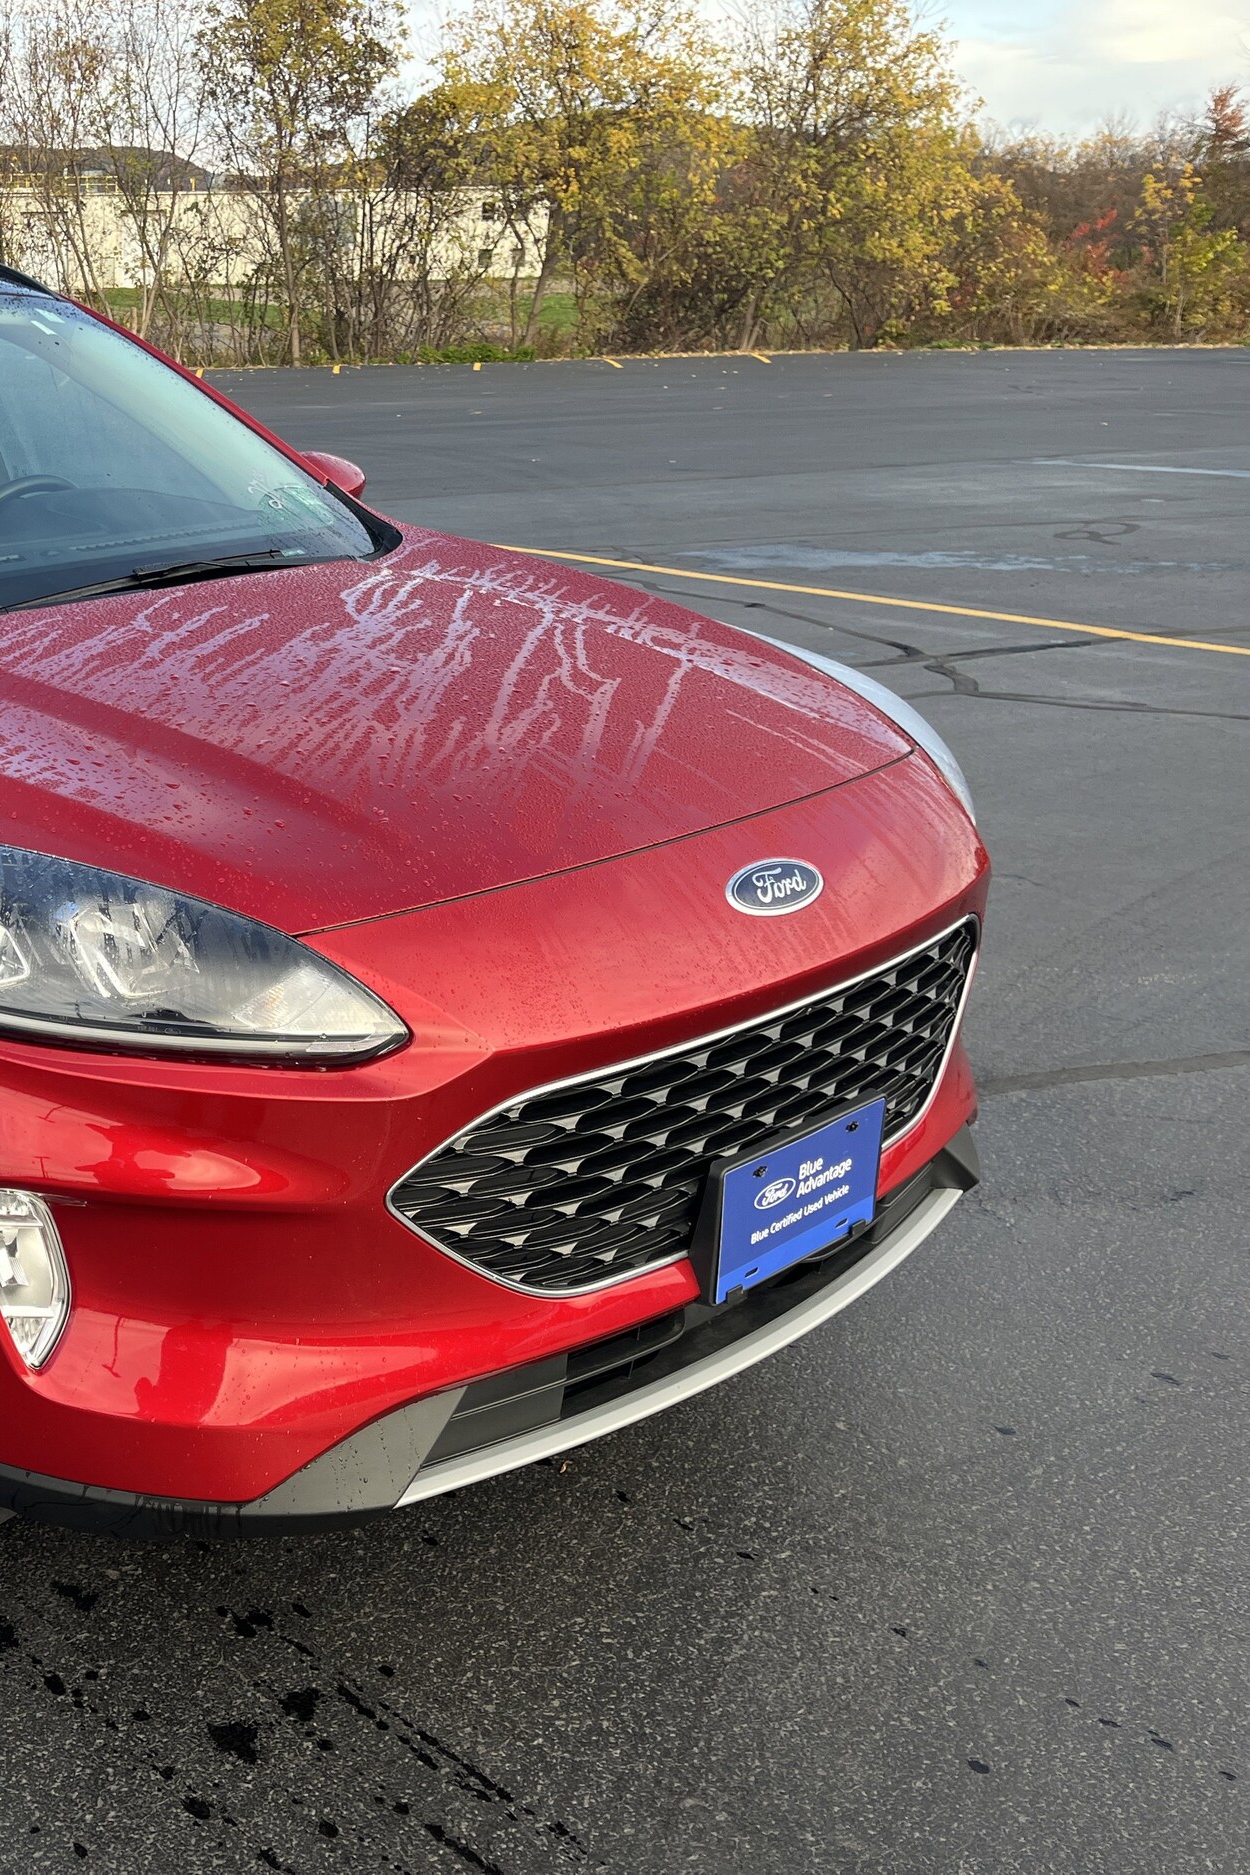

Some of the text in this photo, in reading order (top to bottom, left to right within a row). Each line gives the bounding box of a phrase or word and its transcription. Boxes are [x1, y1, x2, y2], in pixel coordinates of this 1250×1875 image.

[752, 867, 806, 903] Ford
[796, 1158, 852, 1199] Advantage
[798, 1157, 823, 1180] Blue
[762, 1182, 789, 1206] Ford
[751, 1184, 849, 1245] Blue Certified Used Vehicle
